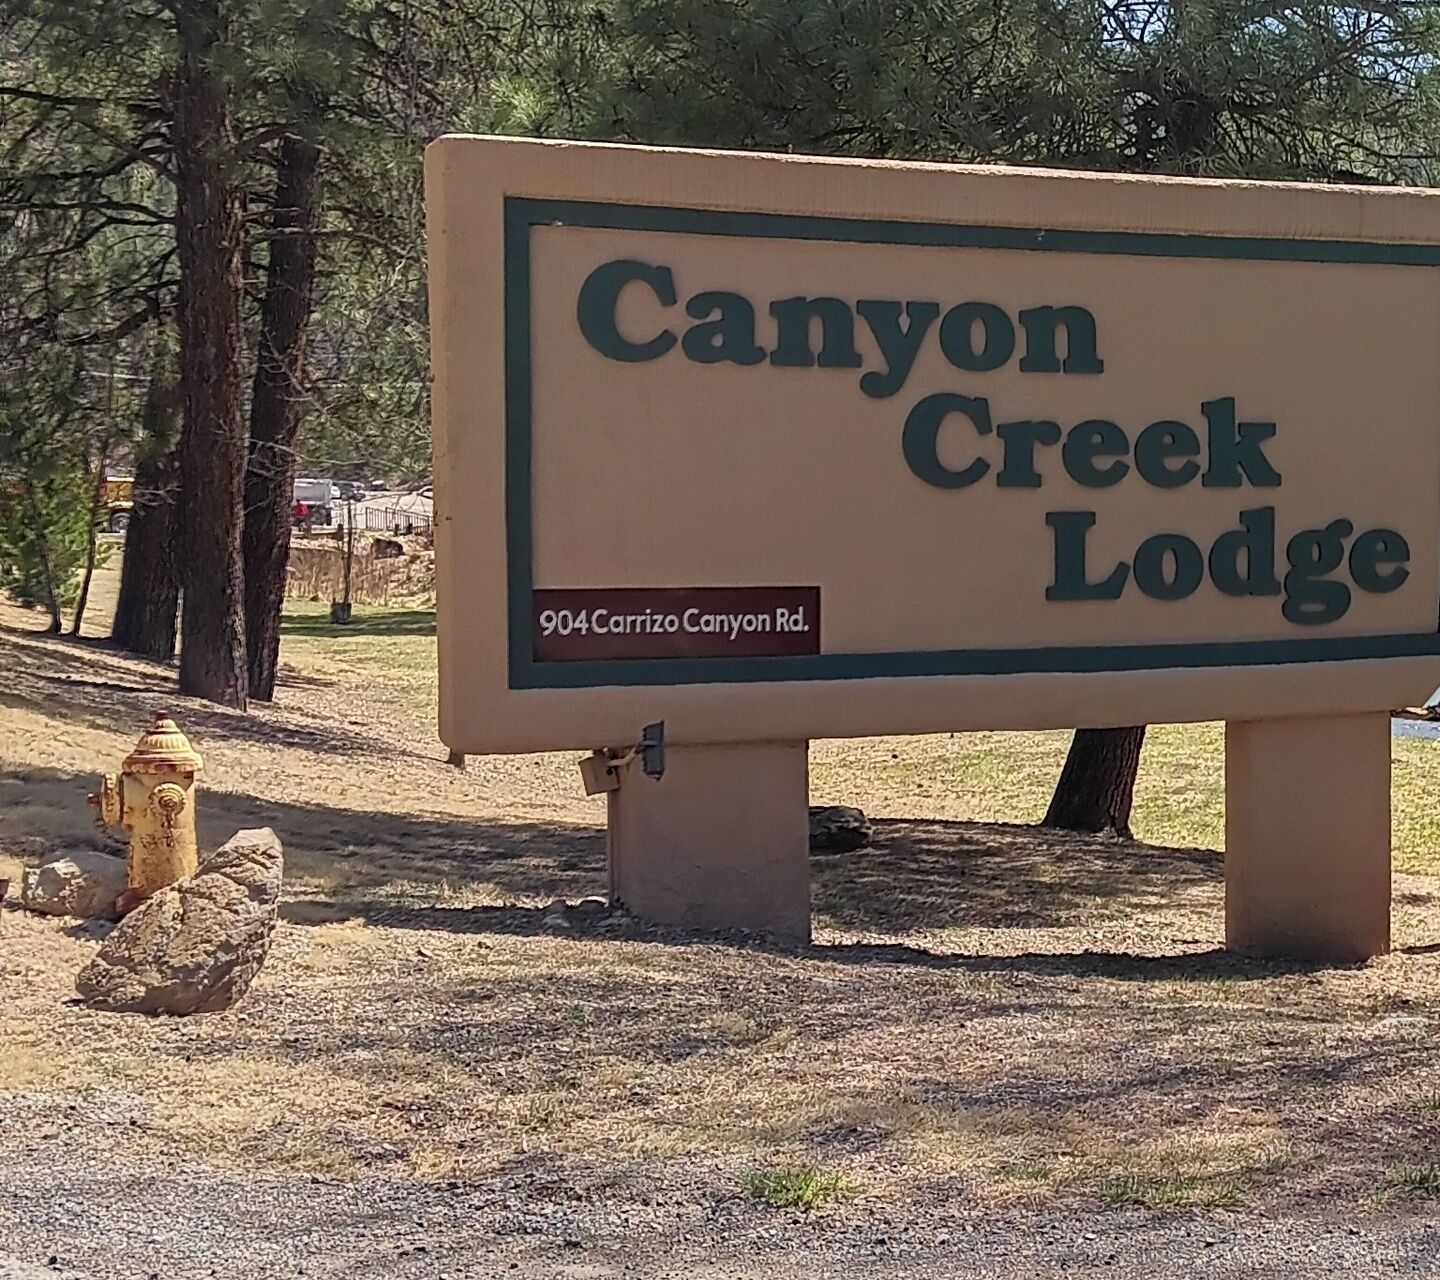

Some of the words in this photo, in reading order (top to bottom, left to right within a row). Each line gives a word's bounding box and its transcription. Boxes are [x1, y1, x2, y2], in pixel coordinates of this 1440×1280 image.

[577, 259, 1104, 398] Canyon
[901, 394, 1282, 490] Creek
[1044, 506, 1411, 626] Lodge
[539, 609, 589, 637] 904
[591, 608, 680, 636] Carrizo
[683, 607, 771, 641] Canyon
[775, 606, 810, 633] Rd.
